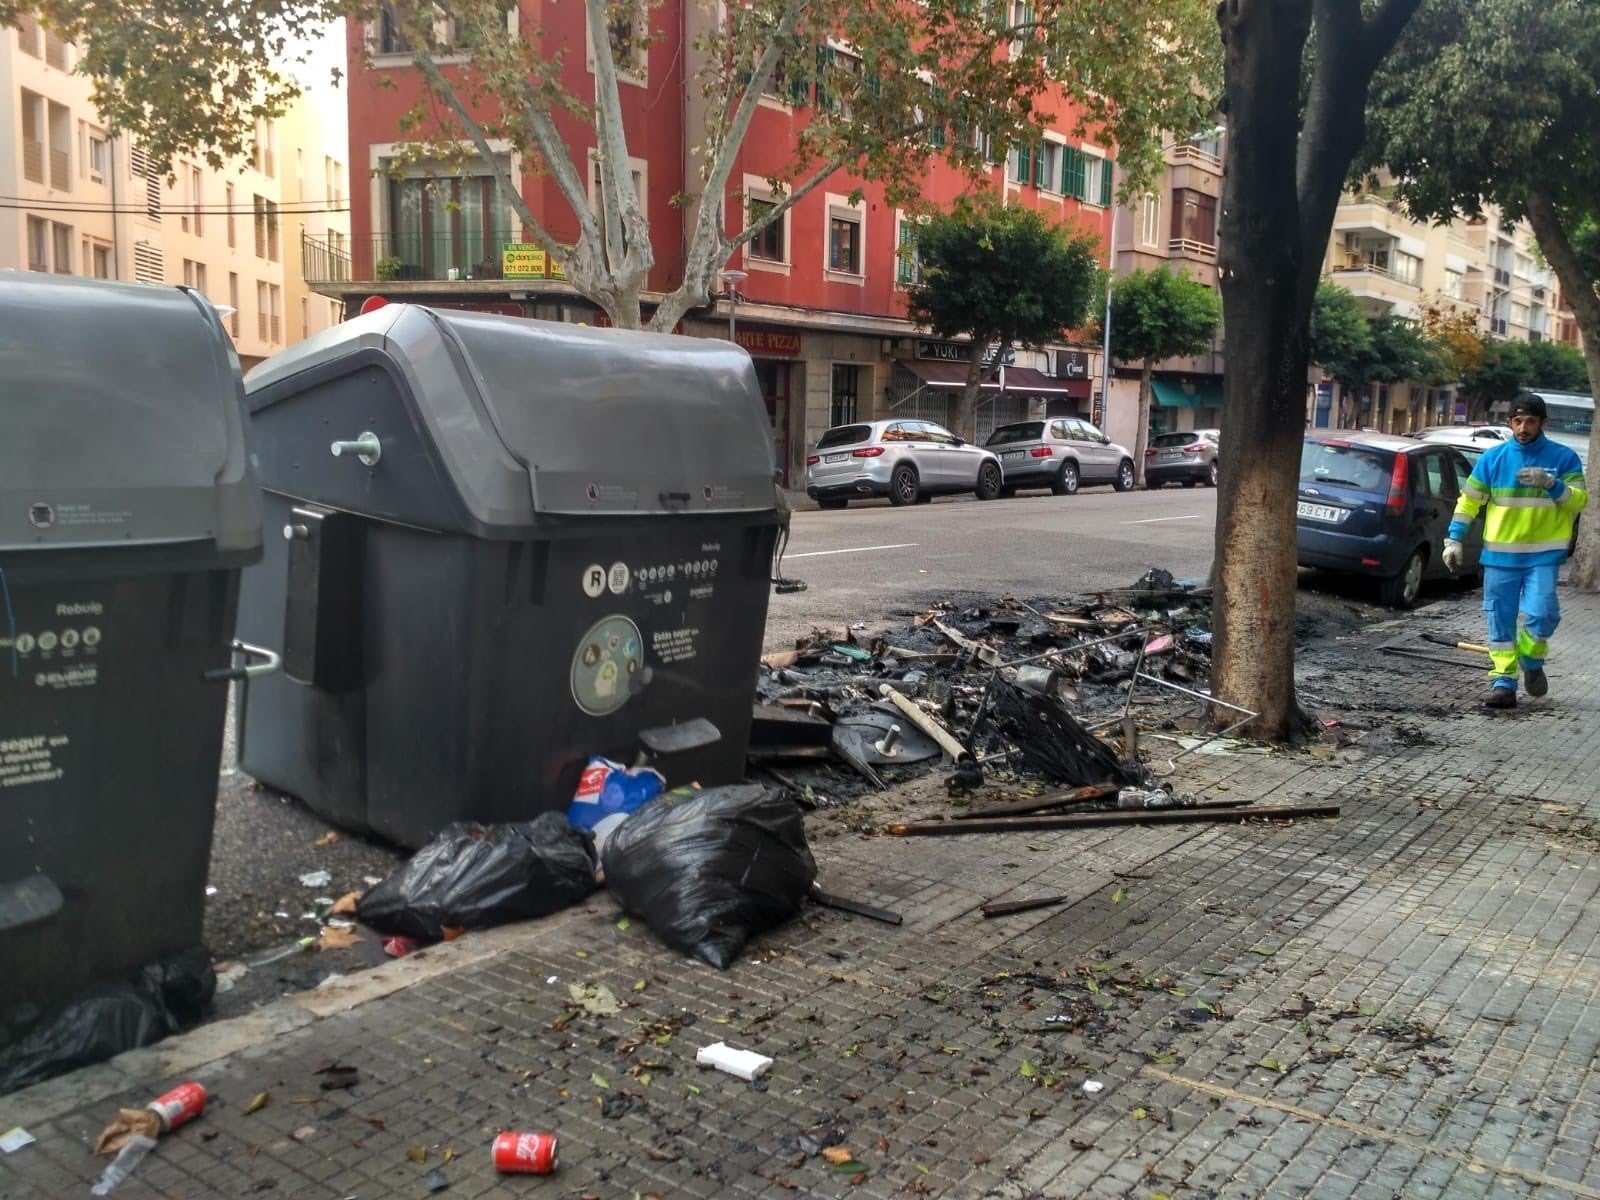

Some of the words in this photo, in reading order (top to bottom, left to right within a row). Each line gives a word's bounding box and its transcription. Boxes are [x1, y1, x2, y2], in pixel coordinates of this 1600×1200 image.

[767, 334, 800, 350] PIZZA
[933, 343, 958, 359] YUKI
[1297, 503, 1313, 515] 69
[591, 570, 601, 587] R
[56, 602, 102, 616] Rebuig
[0, 736, 46, 752] segur
